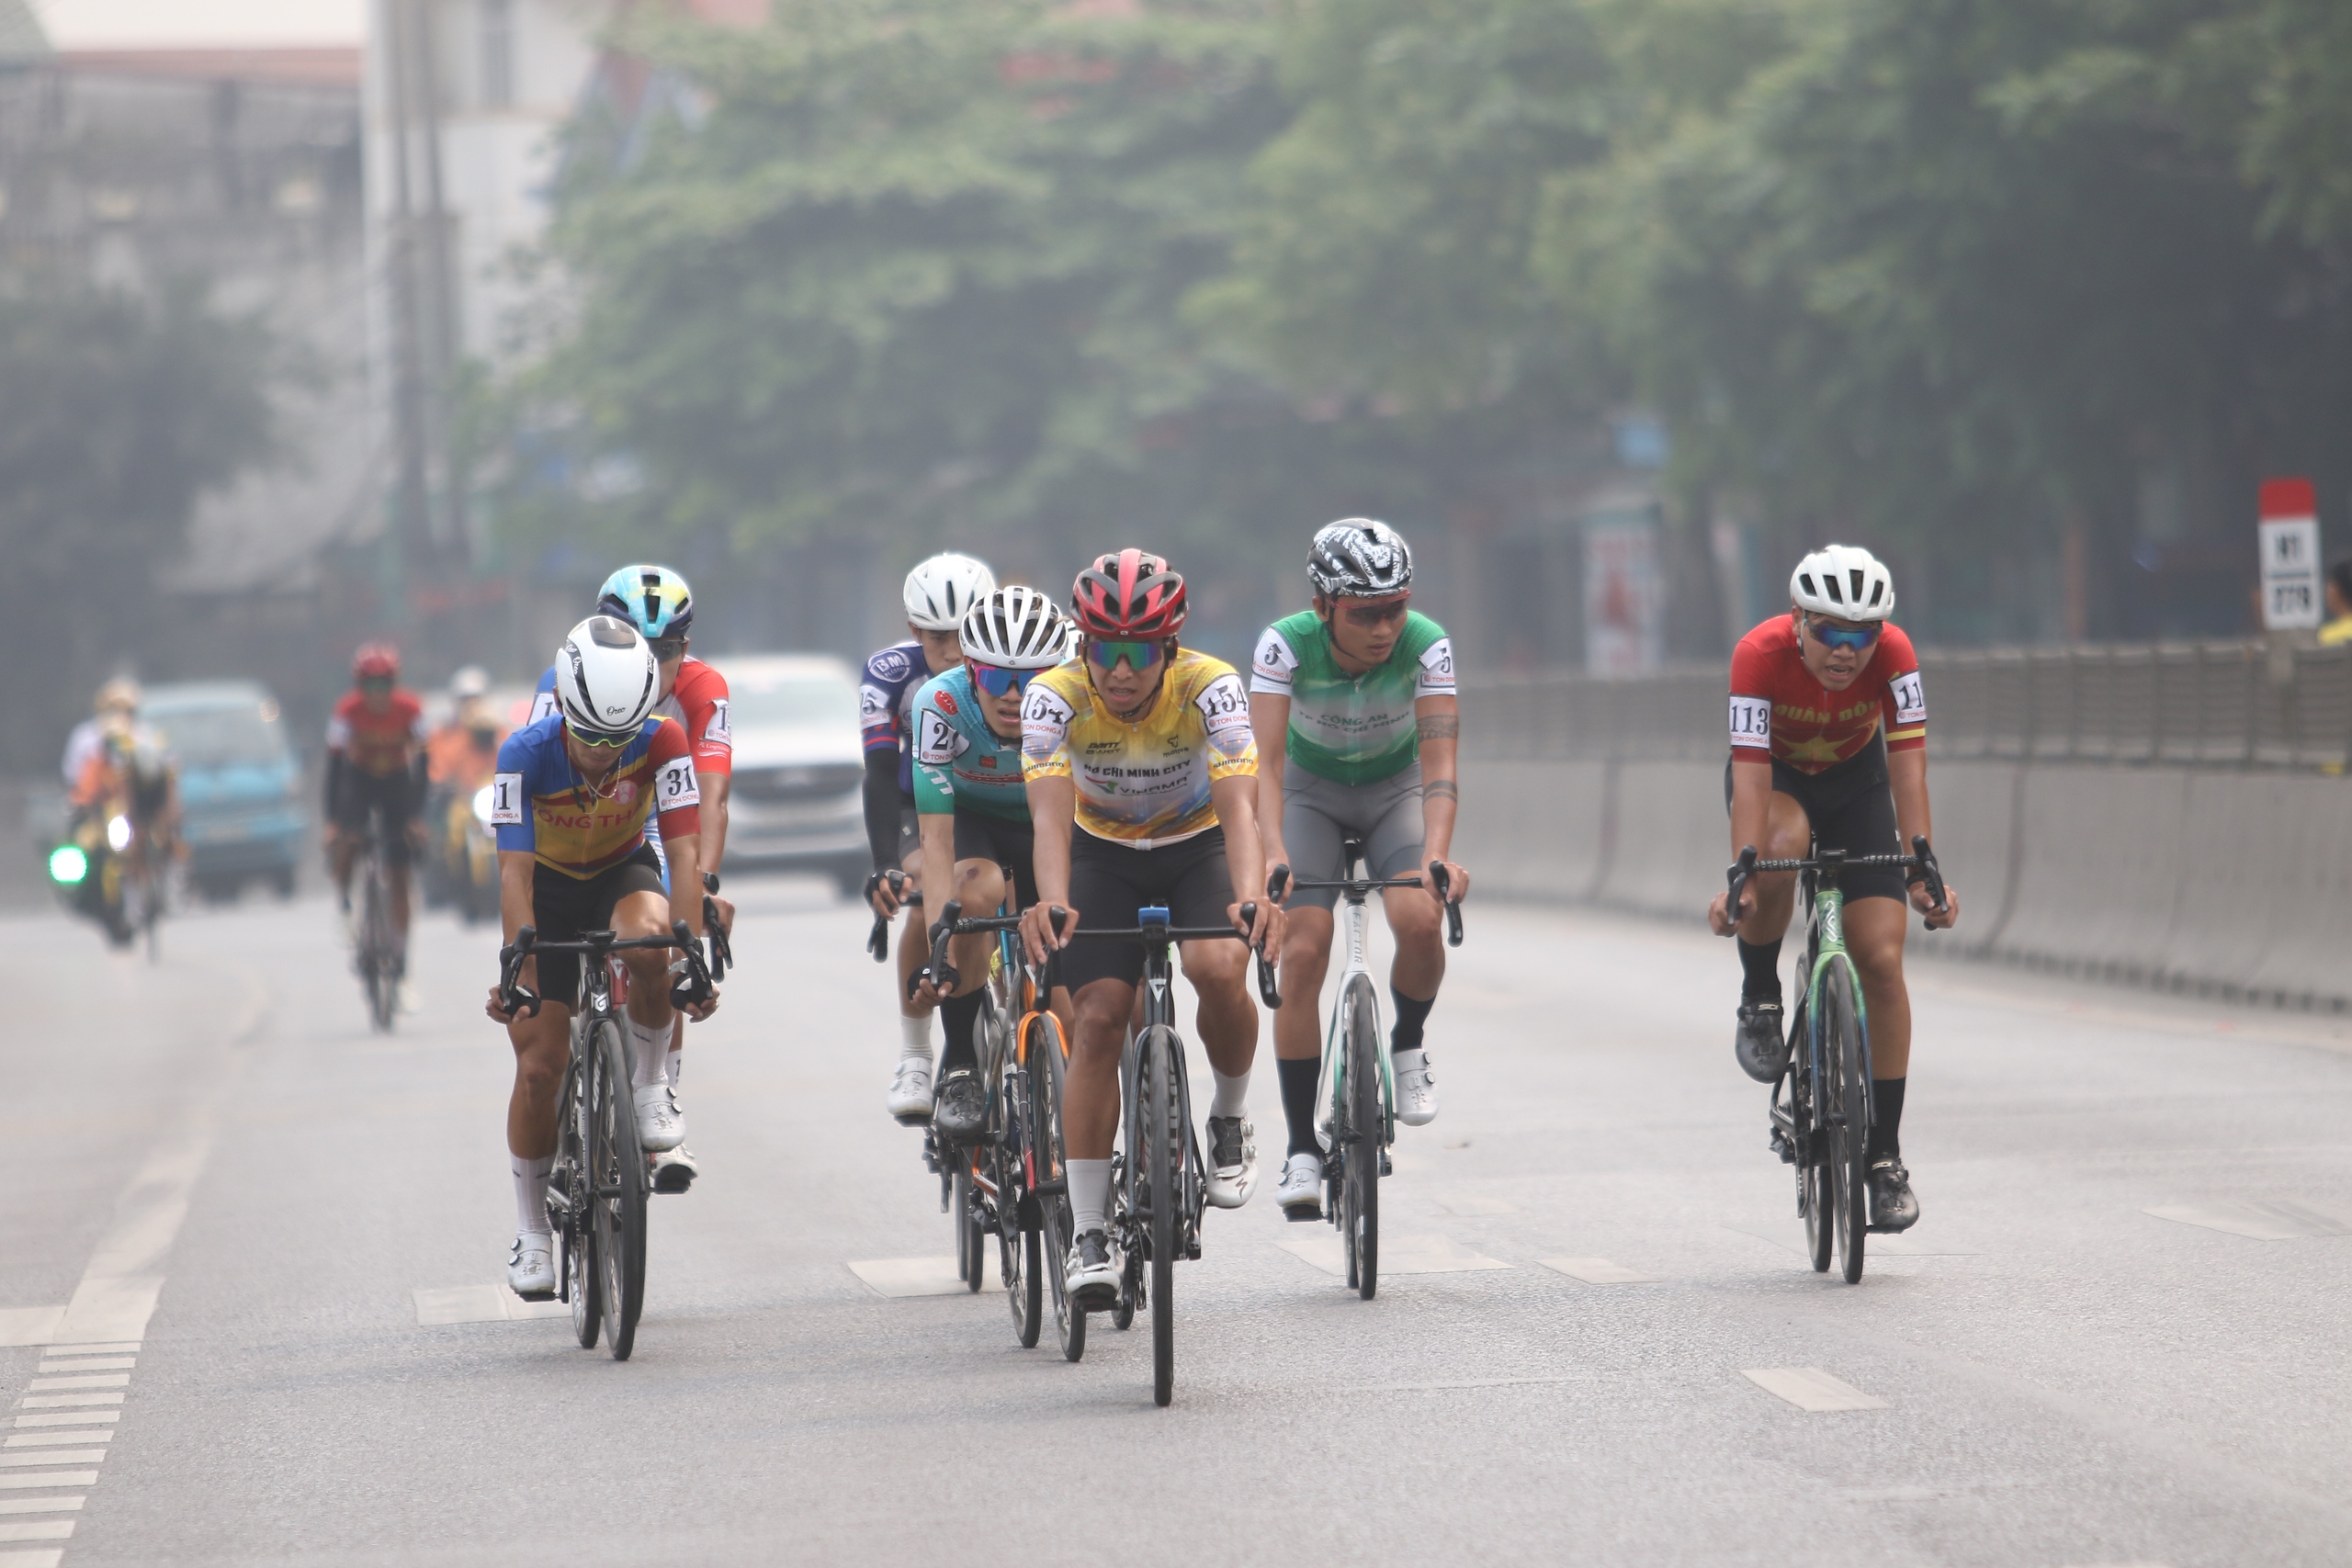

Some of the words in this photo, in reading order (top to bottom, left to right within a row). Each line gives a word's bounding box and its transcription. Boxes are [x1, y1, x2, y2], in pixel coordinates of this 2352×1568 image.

[876, 655, 905, 672] BM
[606, 705, 626, 716] Oreo
[860, 692, 877, 716] 5
[1216, 717, 1232, 726] TON
[1367, 714, 1388, 723] AN
[1731, 705, 1769, 736] 113
[1035, 725, 1057, 734] DONG
[1102, 767, 1124, 778] CHI
[1126, 768, 1159, 778] MINH
[1162, 760, 1191, 775] CITY
[666, 765, 695, 796] 31
[493, 783, 511, 810] 1
[668, 797, 682, 806] TON
[1352, 912, 1363, 964] FACTOR
